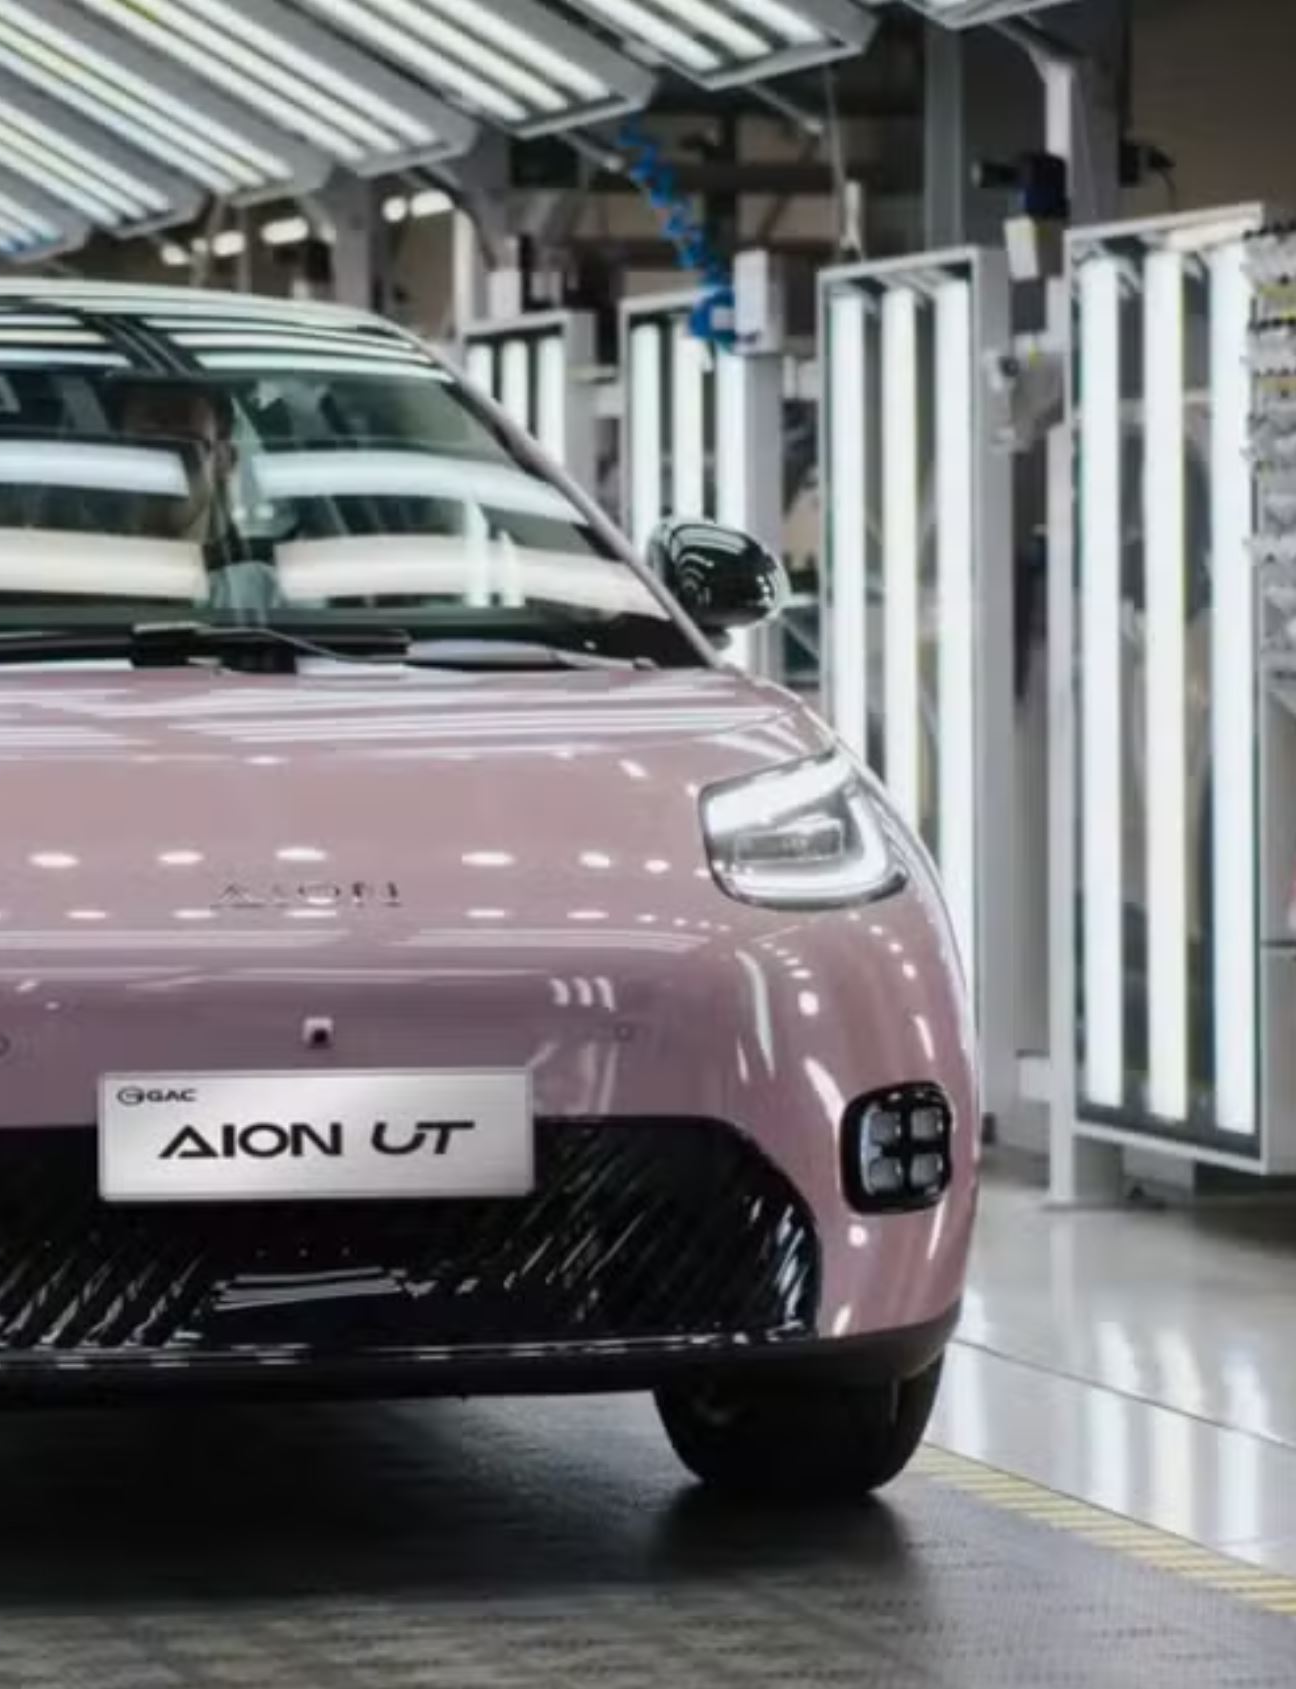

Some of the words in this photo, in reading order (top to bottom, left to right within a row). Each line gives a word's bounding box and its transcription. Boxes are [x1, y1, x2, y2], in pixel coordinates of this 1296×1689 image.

[146, 1088, 198, 1103] GAC
[159, 1122, 343, 1159] AION
[371, 1120, 476, 1155] UT
